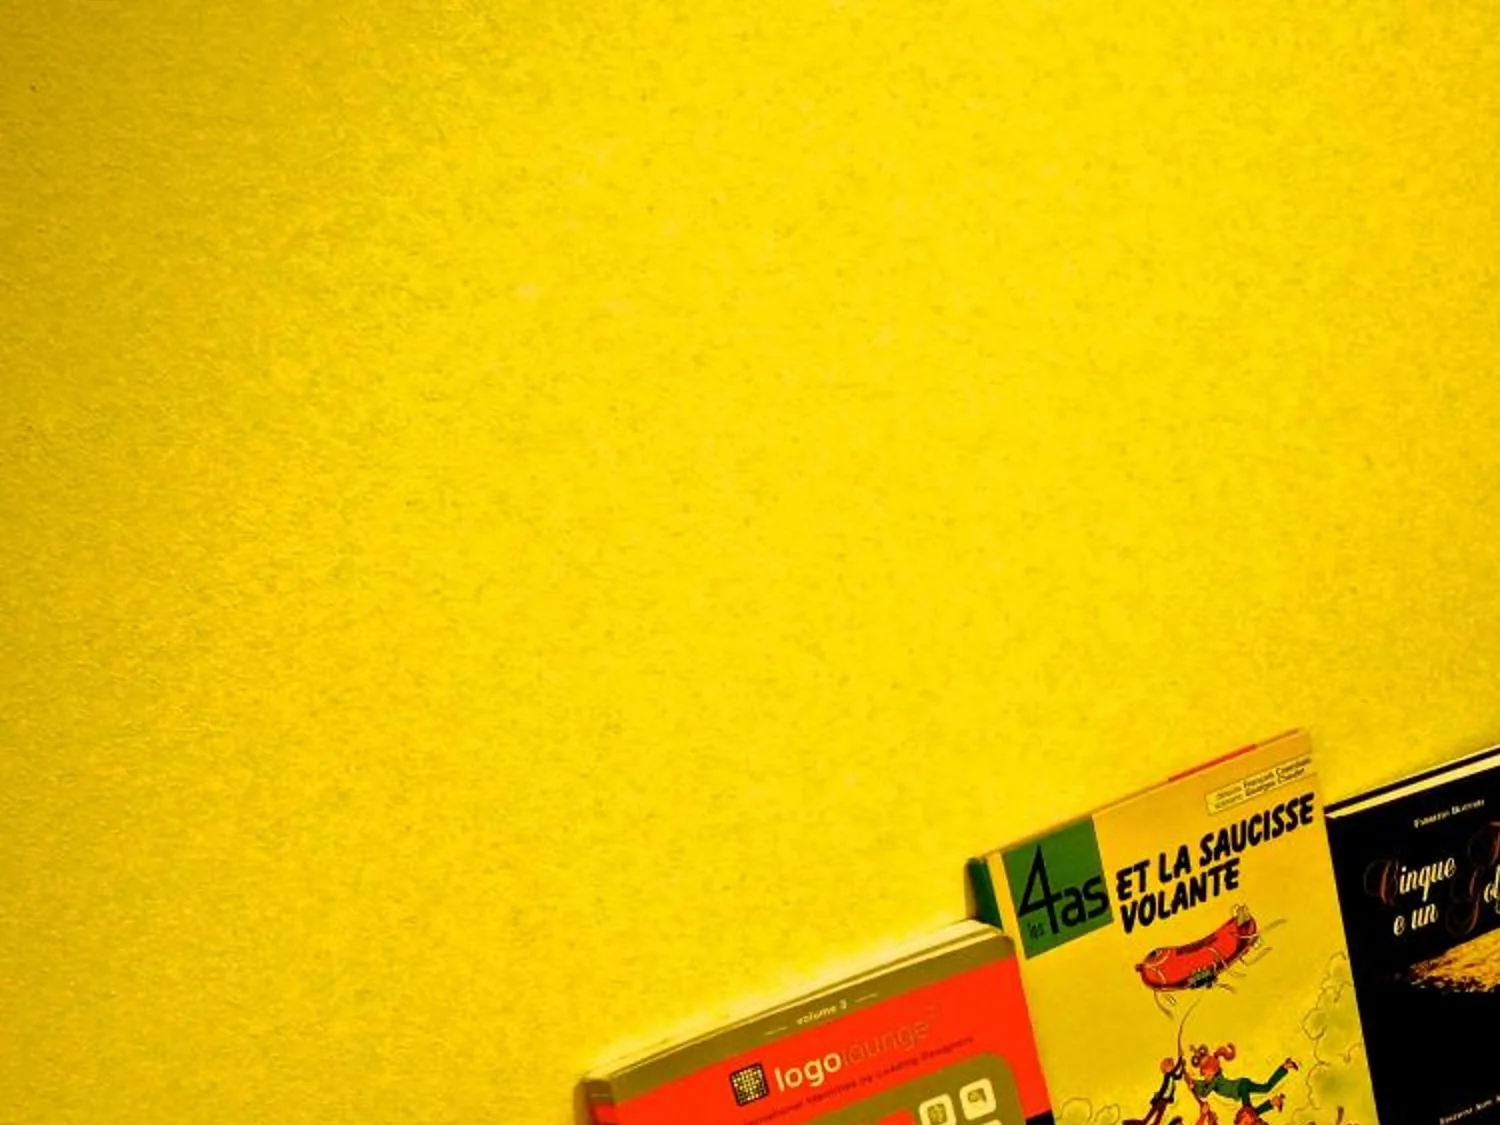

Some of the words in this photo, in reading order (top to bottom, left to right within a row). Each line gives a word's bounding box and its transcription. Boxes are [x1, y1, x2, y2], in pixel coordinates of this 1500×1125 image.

[1116, 859, 1150, 901] ET
[1158, 845, 1191, 881] LA
[1200, 792, 1315, 867] SAUCISSE
[1120, 858, 1240, 933] VOLANTE
[1412, 904, 1438, 930] un
[797, 1006, 836, 1024] volume
